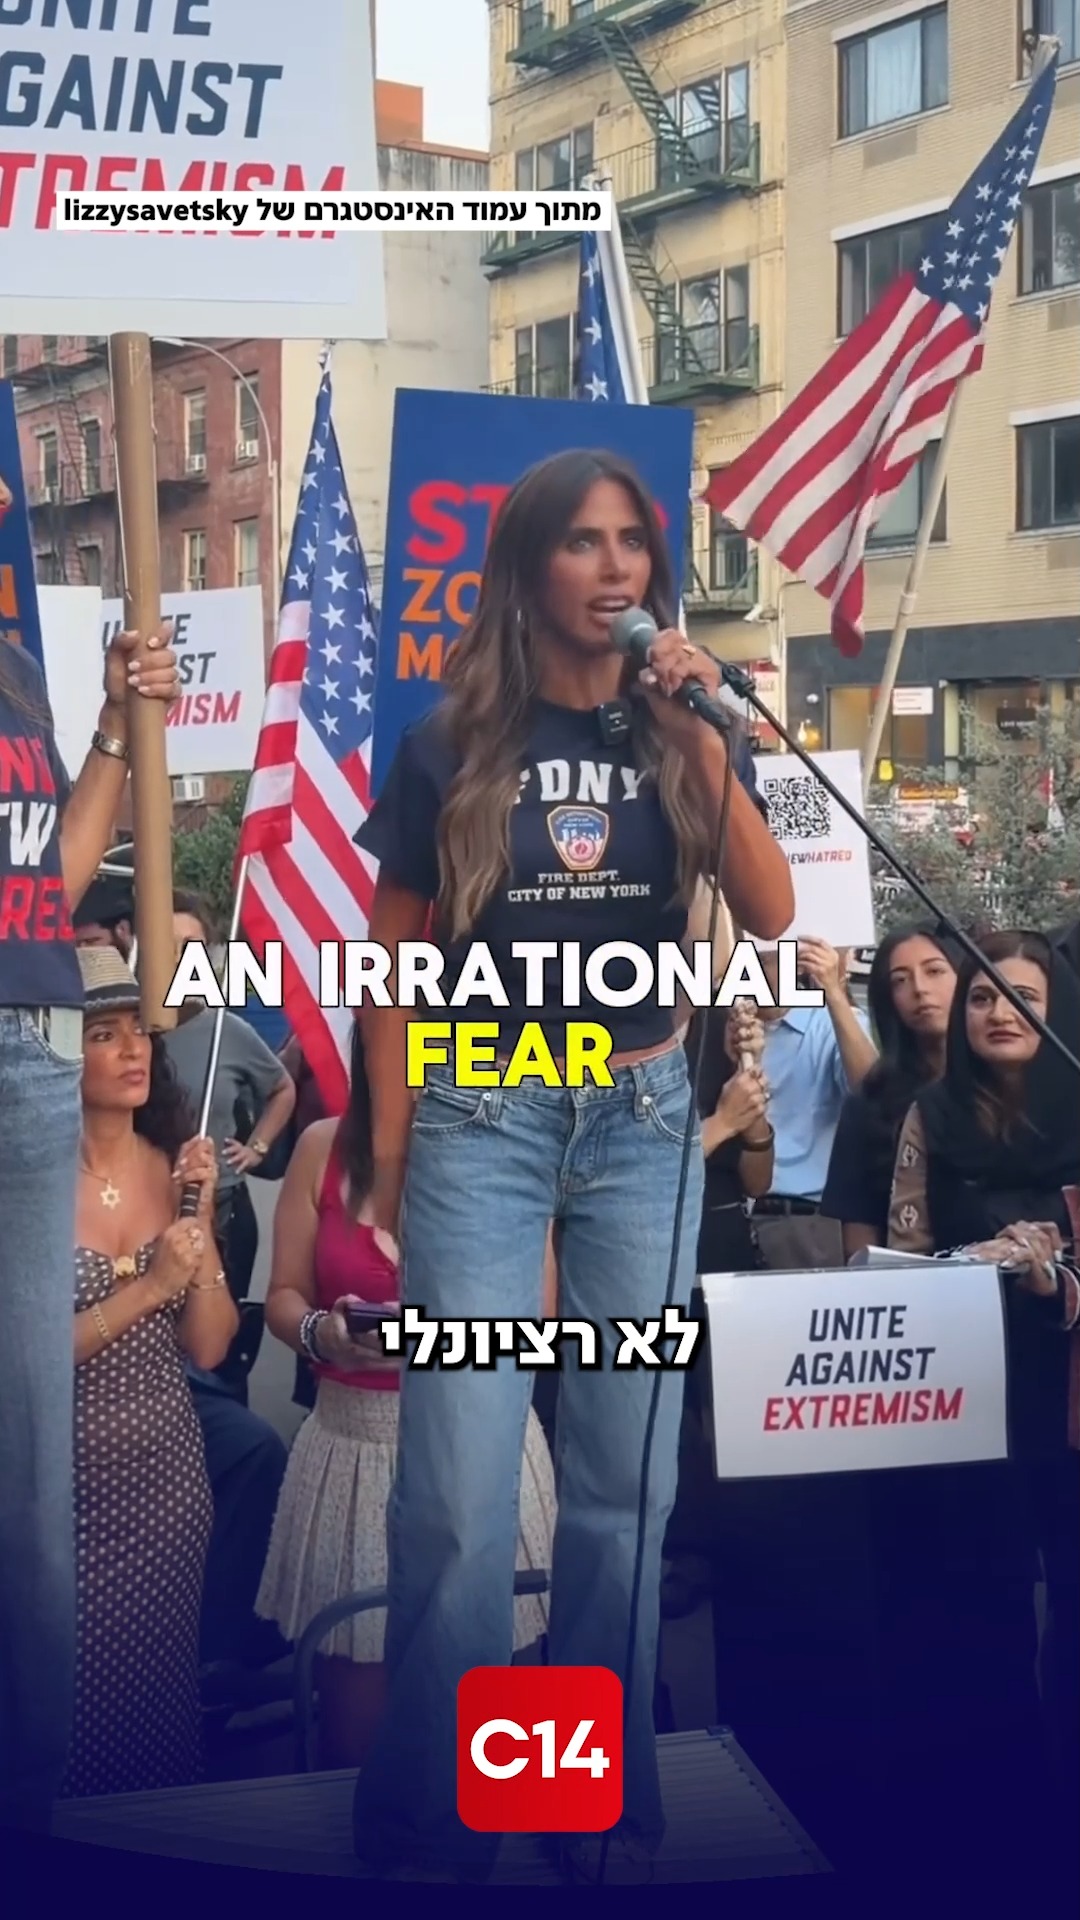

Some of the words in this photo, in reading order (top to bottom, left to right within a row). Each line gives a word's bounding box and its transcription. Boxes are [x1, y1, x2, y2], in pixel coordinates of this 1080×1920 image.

[507, 888, 544, 902] CITY
[546, 887, 566, 900] OF
[569, 885, 607, 899] NEW
[609, 884, 651, 898] YORK
[537, 872, 574, 885] FIRE
[577, 869, 621, 882] DEPT.
[808, 1305, 907, 1342] UNITE
[785, 1347, 936, 1387] AGAINST
[762, 1387, 963, 1431] EXTREMISM
